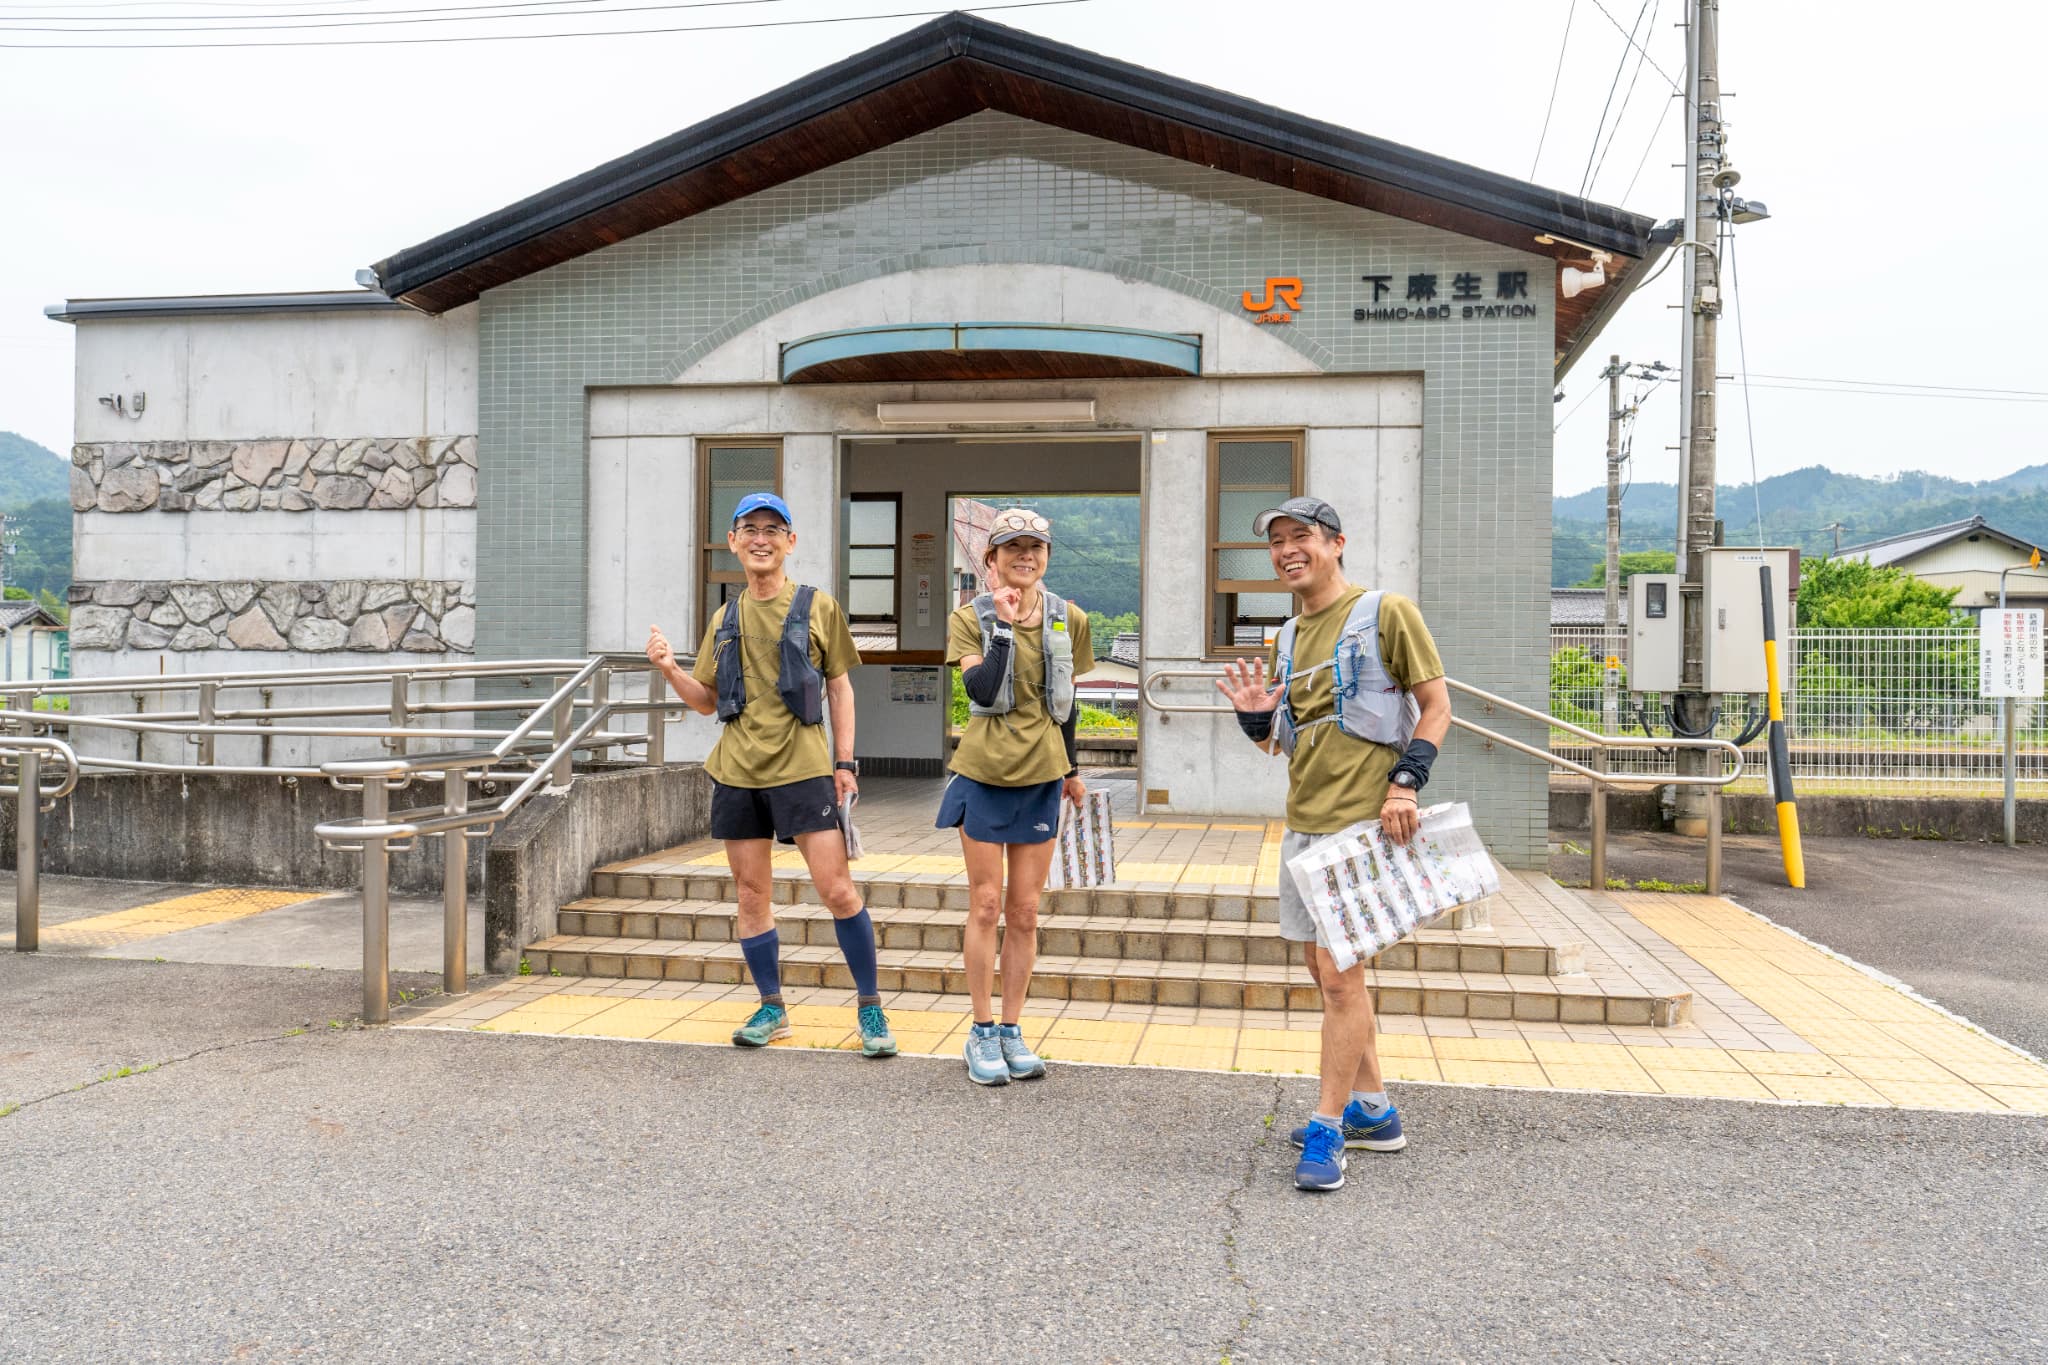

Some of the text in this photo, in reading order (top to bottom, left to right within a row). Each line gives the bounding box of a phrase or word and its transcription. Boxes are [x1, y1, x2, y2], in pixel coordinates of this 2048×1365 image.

[1242, 277, 1303, 311] JR
[1362, 272, 1528, 302] 下麻生駅
[1462, 304, 1536, 318] STATION
